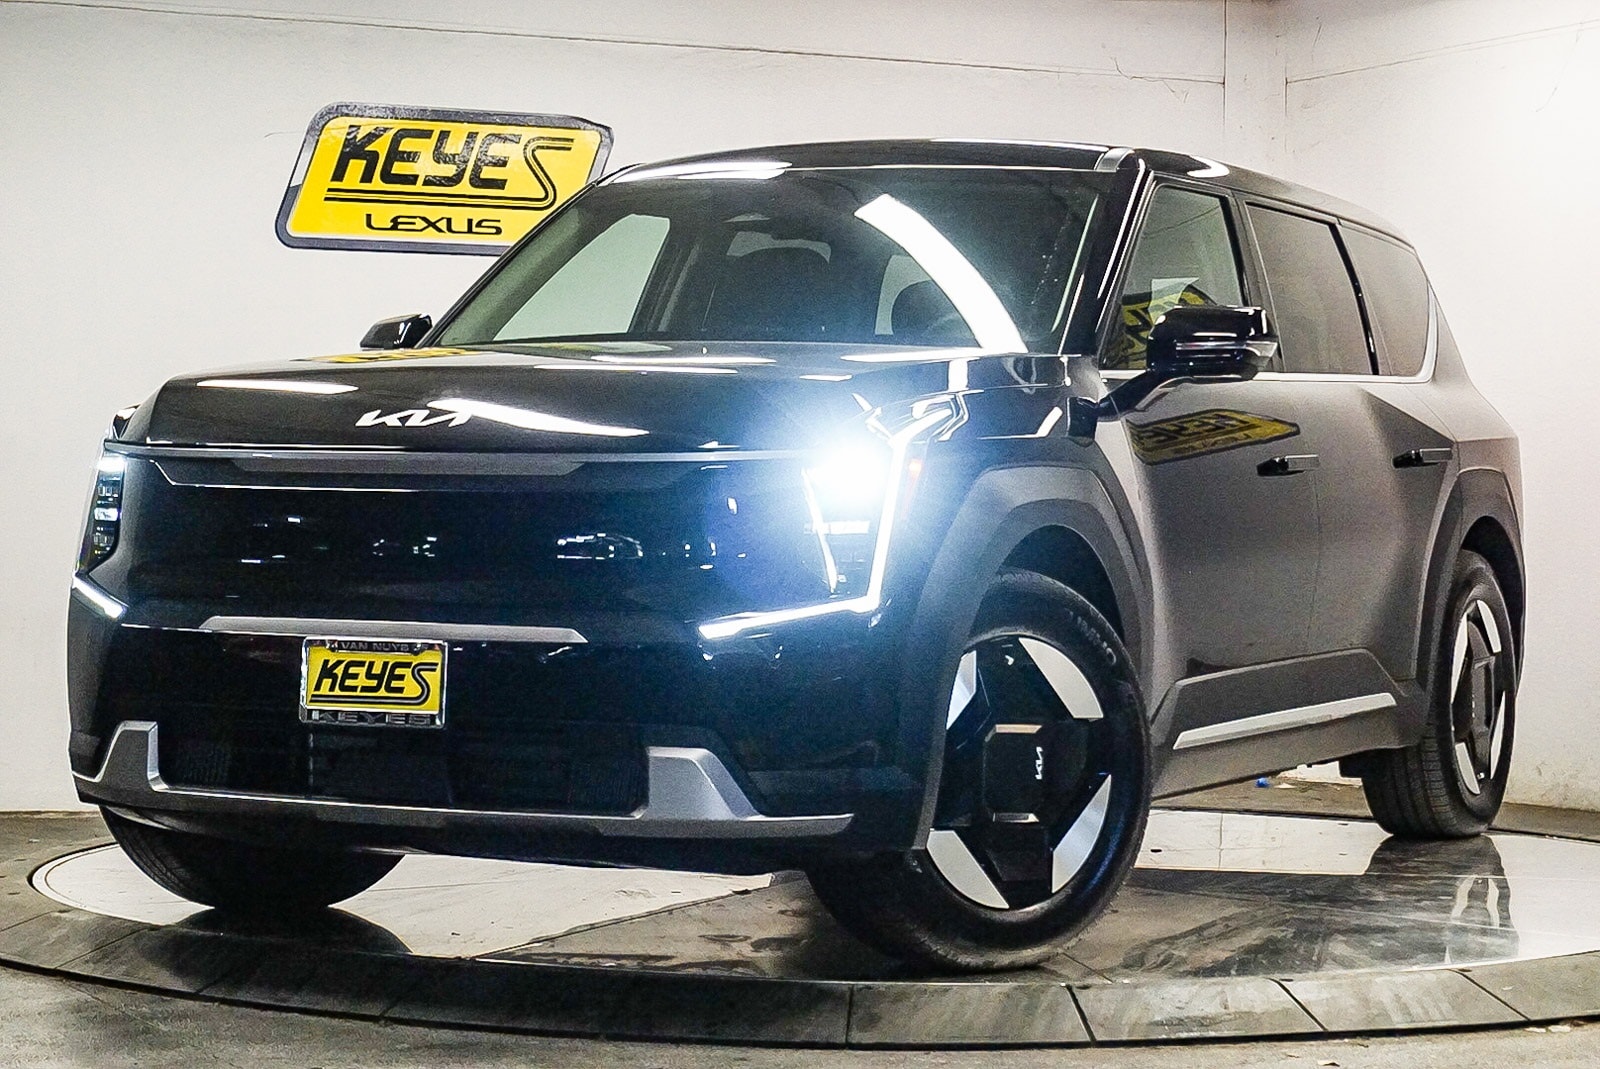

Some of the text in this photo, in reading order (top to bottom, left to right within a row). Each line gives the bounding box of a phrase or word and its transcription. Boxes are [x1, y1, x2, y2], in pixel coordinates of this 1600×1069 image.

[324, 124, 575, 211] KEYES
[365, 213, 503, 236] LEXUS
[341, 641, 369, 650] VAN
[309, 659, 439, 706] KEYES
[312, 710, 431, 725] KEYES
